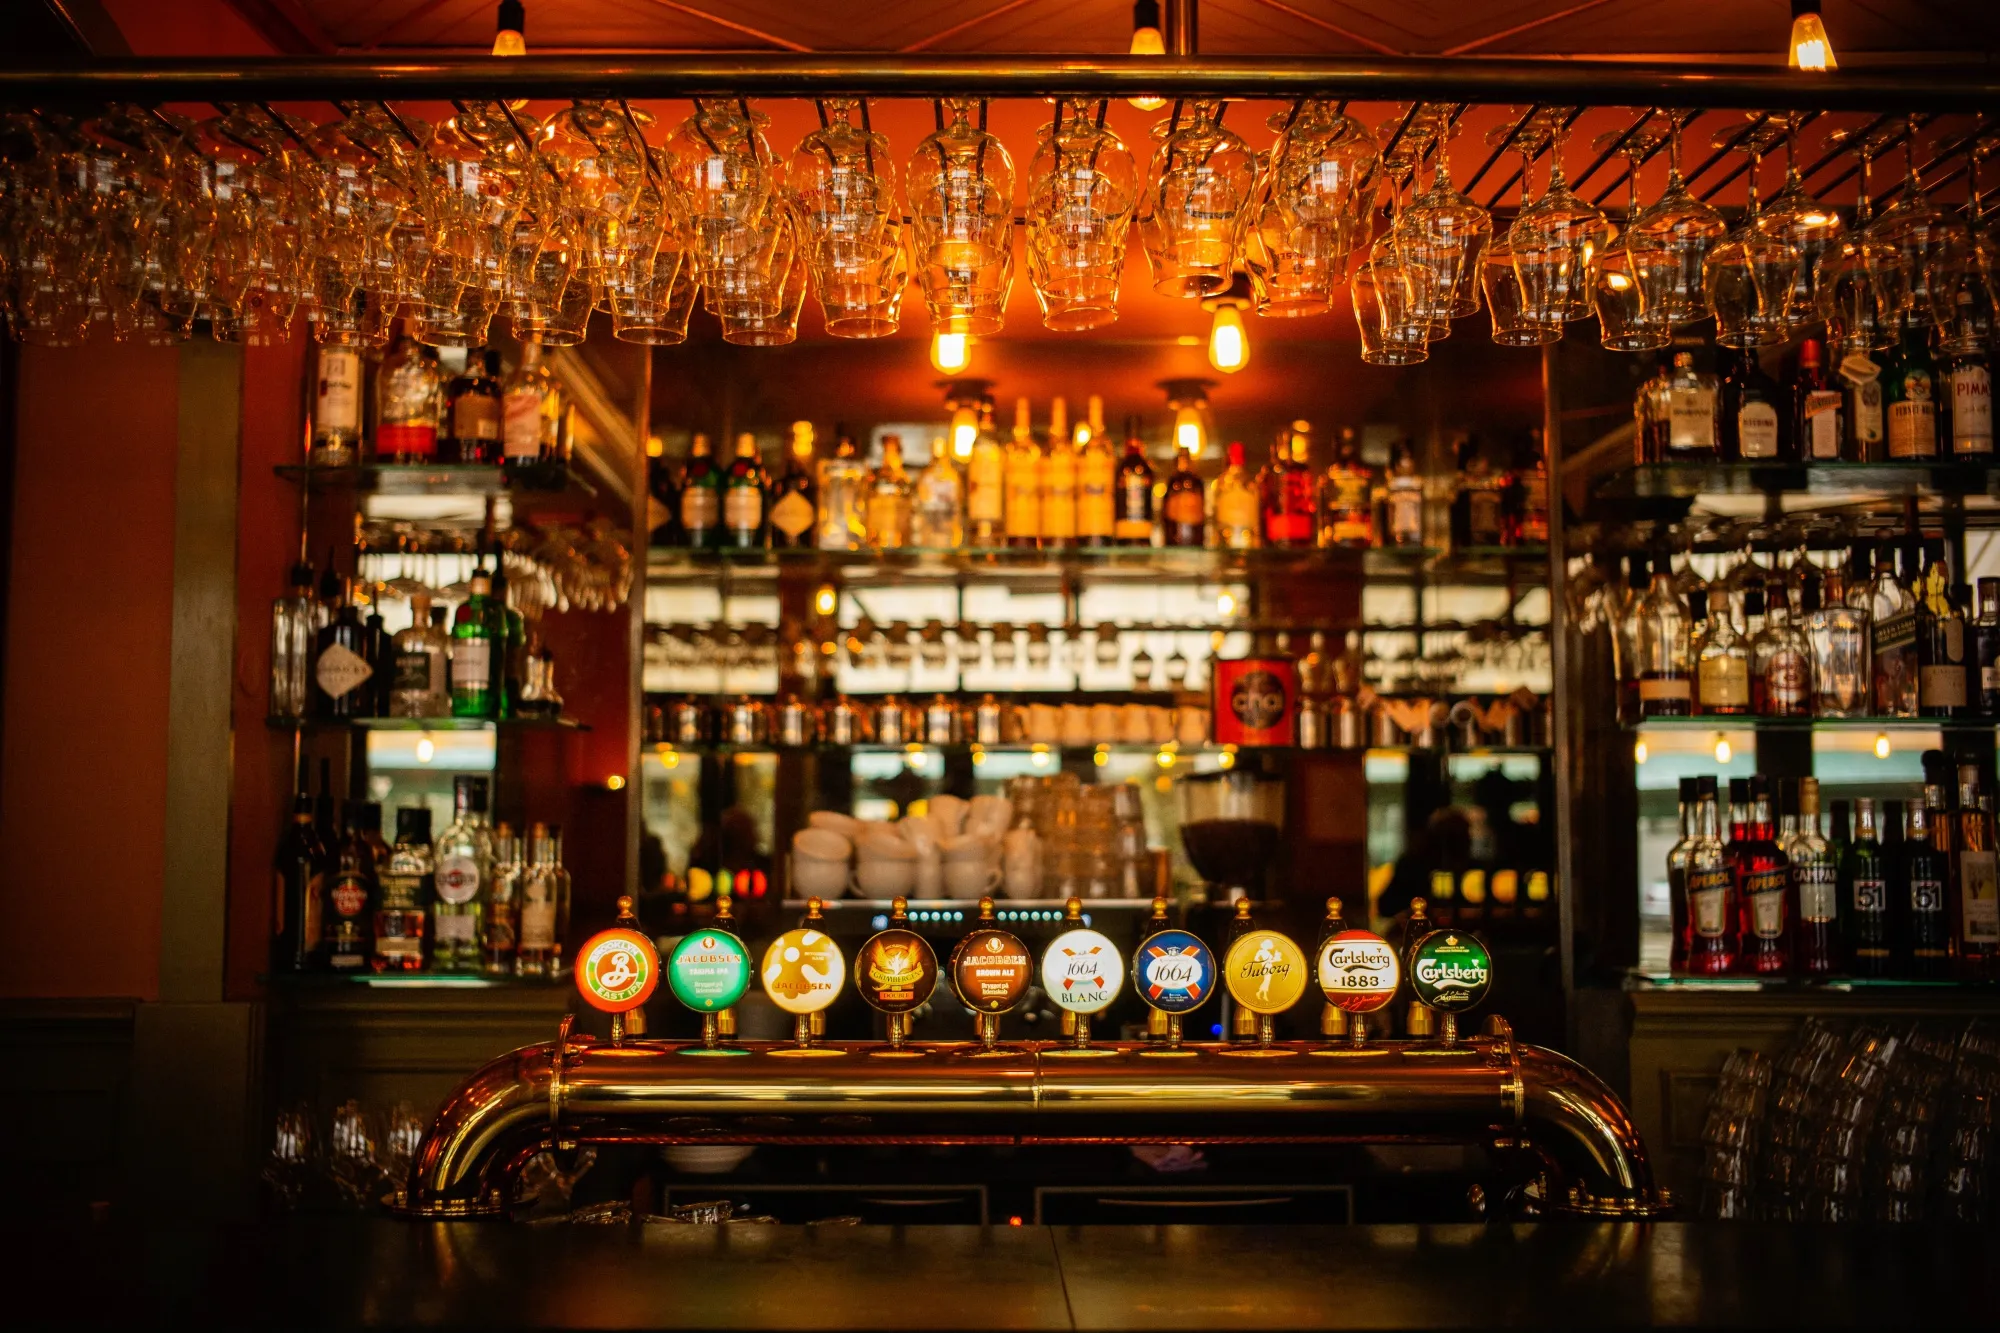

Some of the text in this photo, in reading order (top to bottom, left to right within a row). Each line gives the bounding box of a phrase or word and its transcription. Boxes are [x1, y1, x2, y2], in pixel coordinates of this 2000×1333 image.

[1859, 885, 1883, 908] 51
[1916, 886, 1941, 908] 51
[592, 941, 640, 962] BROOKLYN
[676, 954, 742, 965] JACOBSEN
[1329, 948, 1390, 971] Carlsberg
[963, 955, 1027, 966] JACOBSEN
[1067, 961, 1098, 976] 1664
[1240, 956, 1291, 981] Tuborg
[873, 971, 920, 983] GRIMBERGEN
[975, 969, 1001, 977] BROWN
[1155, 963, 1193, 982] 1664
[1341, 975, 1379, 987] 1883
[1416, 958, 1488, 987] Carlsberg
[597, 981, 643, 1000] EAST IPA
[774, 982, 832, 990] JACOBSEN
[1061, 990, 1108, 1003] BLANC
